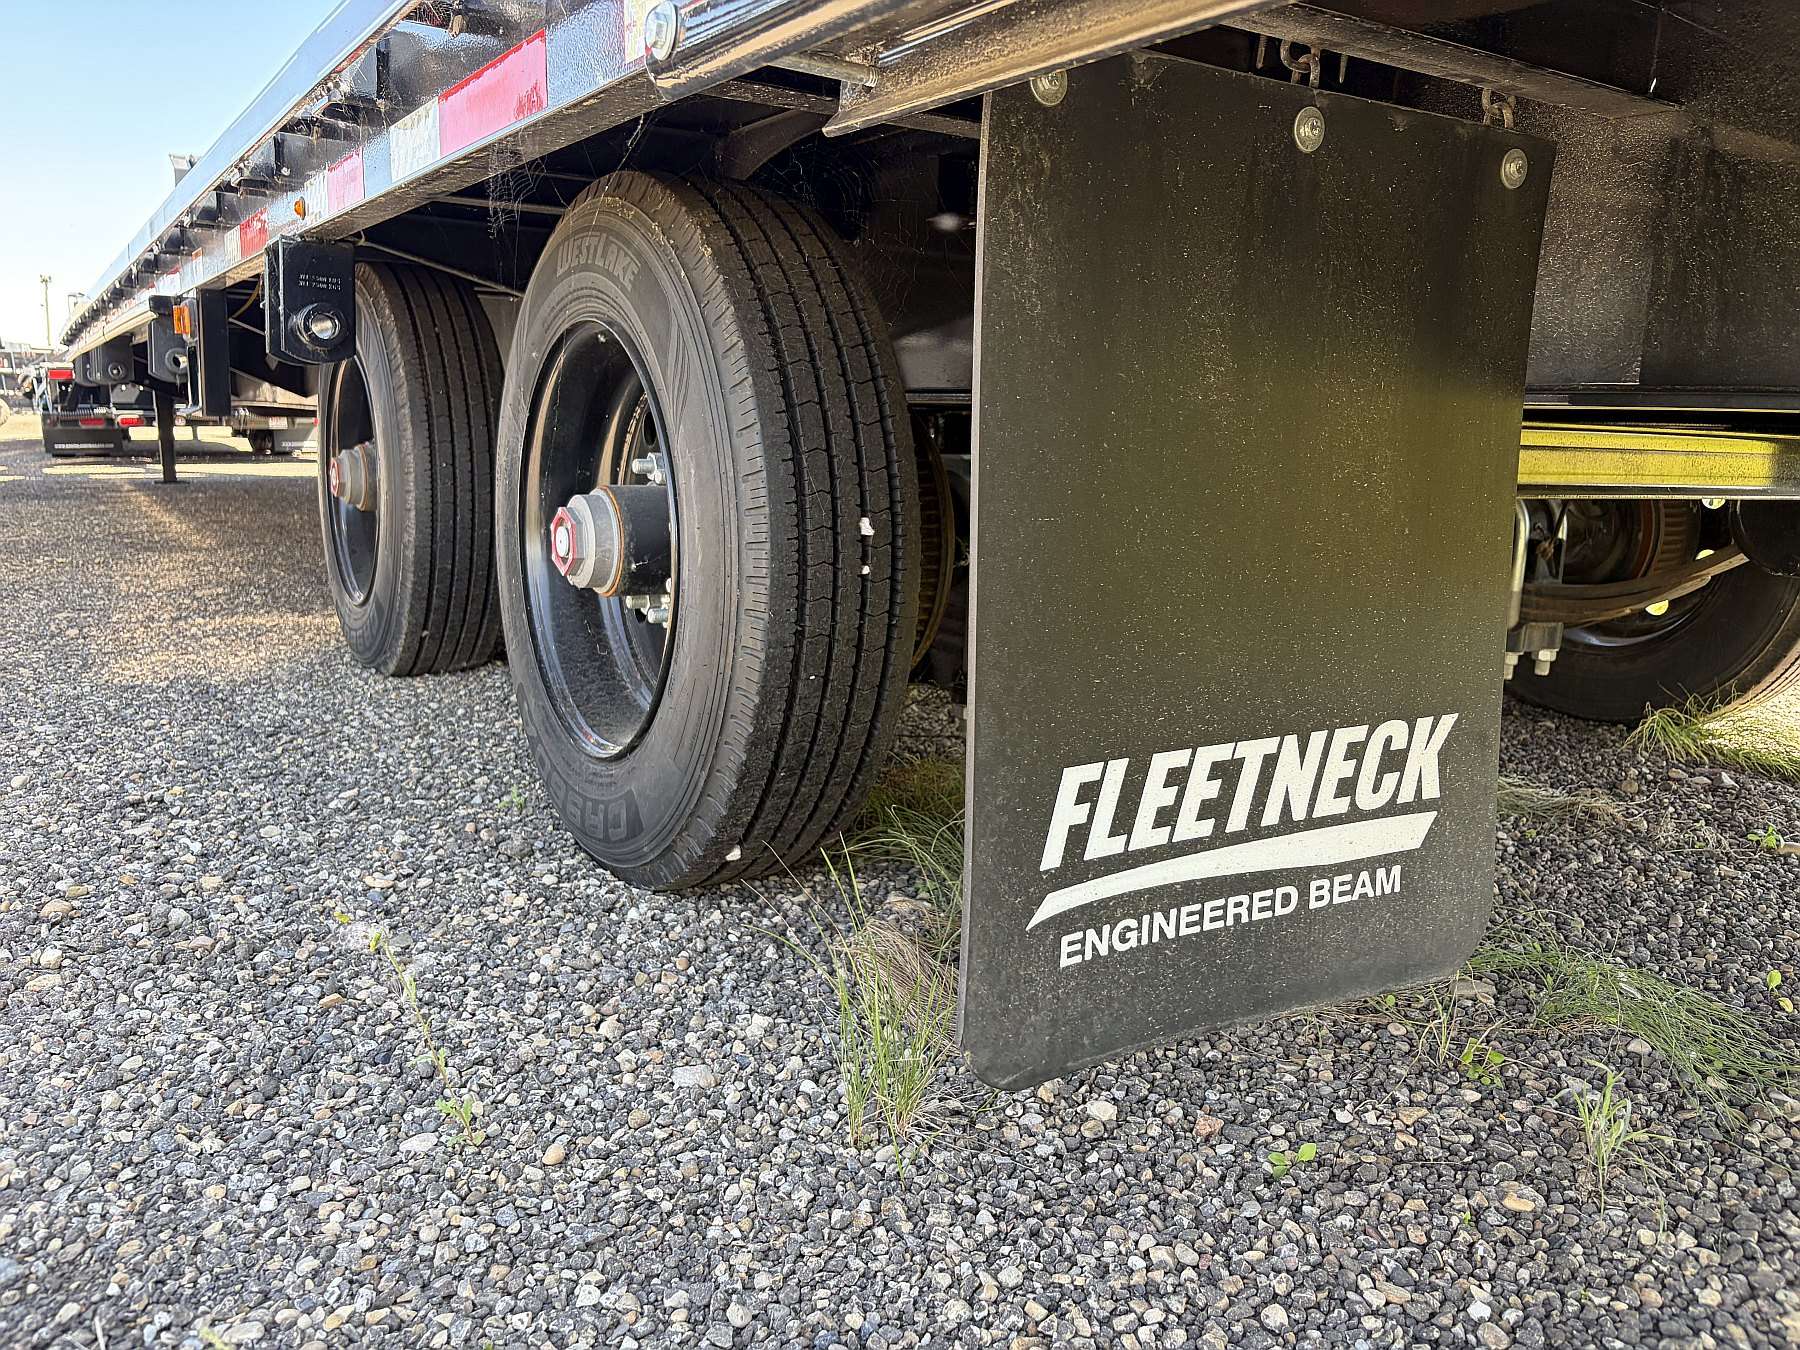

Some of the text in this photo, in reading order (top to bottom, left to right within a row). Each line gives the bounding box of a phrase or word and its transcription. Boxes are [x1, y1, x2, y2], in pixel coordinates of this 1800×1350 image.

[1040, 713, 1458, 871] FLEETNECK
[1059, 865, 1402, 968] ENGINEERED BEAM
